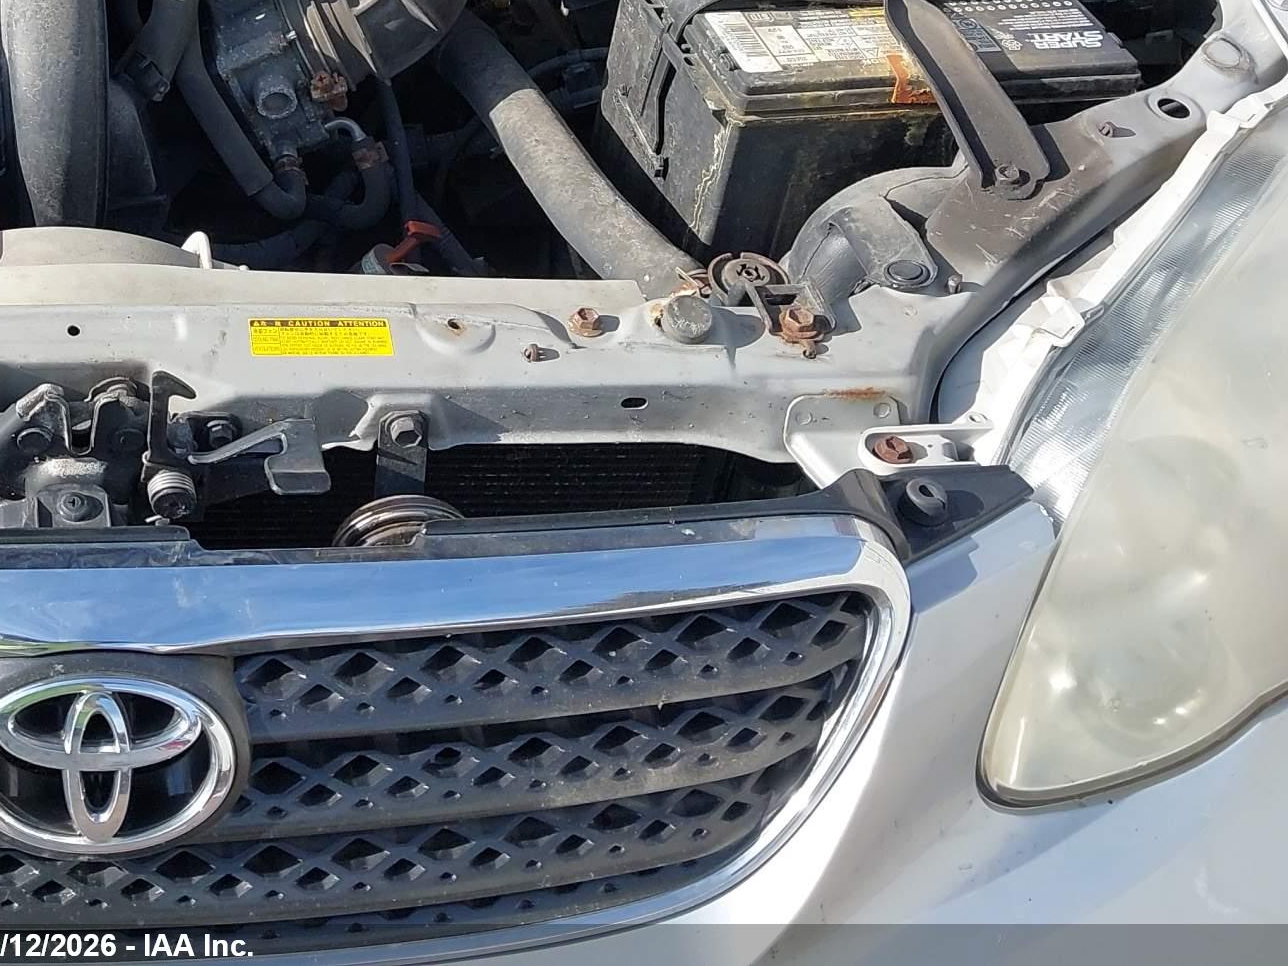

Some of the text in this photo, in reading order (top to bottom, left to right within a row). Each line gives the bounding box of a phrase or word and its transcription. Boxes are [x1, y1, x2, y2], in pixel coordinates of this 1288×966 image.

[1033, 31, 1104, 42] START
[1034, 39, 1102, 49] SUPER
[287, 320, 331, 328] CAUTION
[337, 320, 386, 328] ATTENTION
